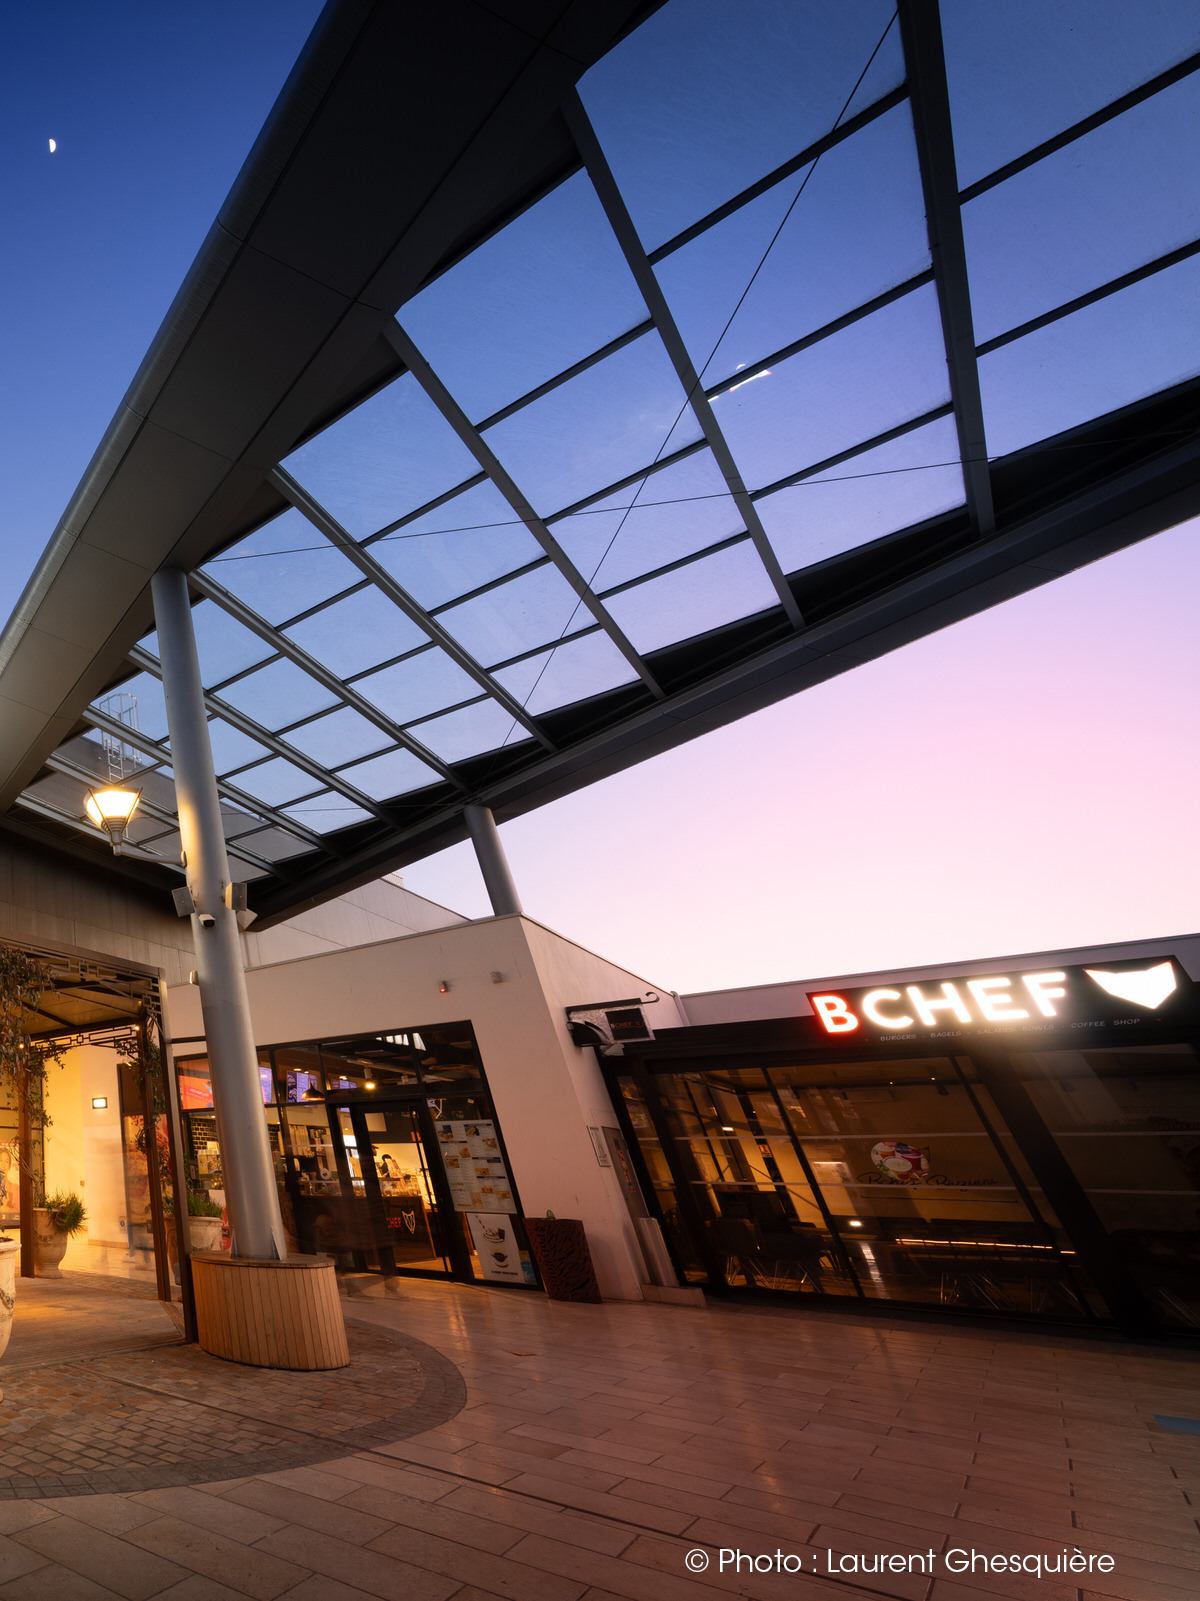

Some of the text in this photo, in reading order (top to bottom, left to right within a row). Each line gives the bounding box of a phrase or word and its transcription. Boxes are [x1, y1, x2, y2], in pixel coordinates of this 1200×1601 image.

[880, 1033, 917, 1042] BURGERS
[930, 1030, 962, 1039] BAGELS
[1071, 1020, 1105, 1029] COFFEE
[1113, 1017, 1141, 1026] SHOP
